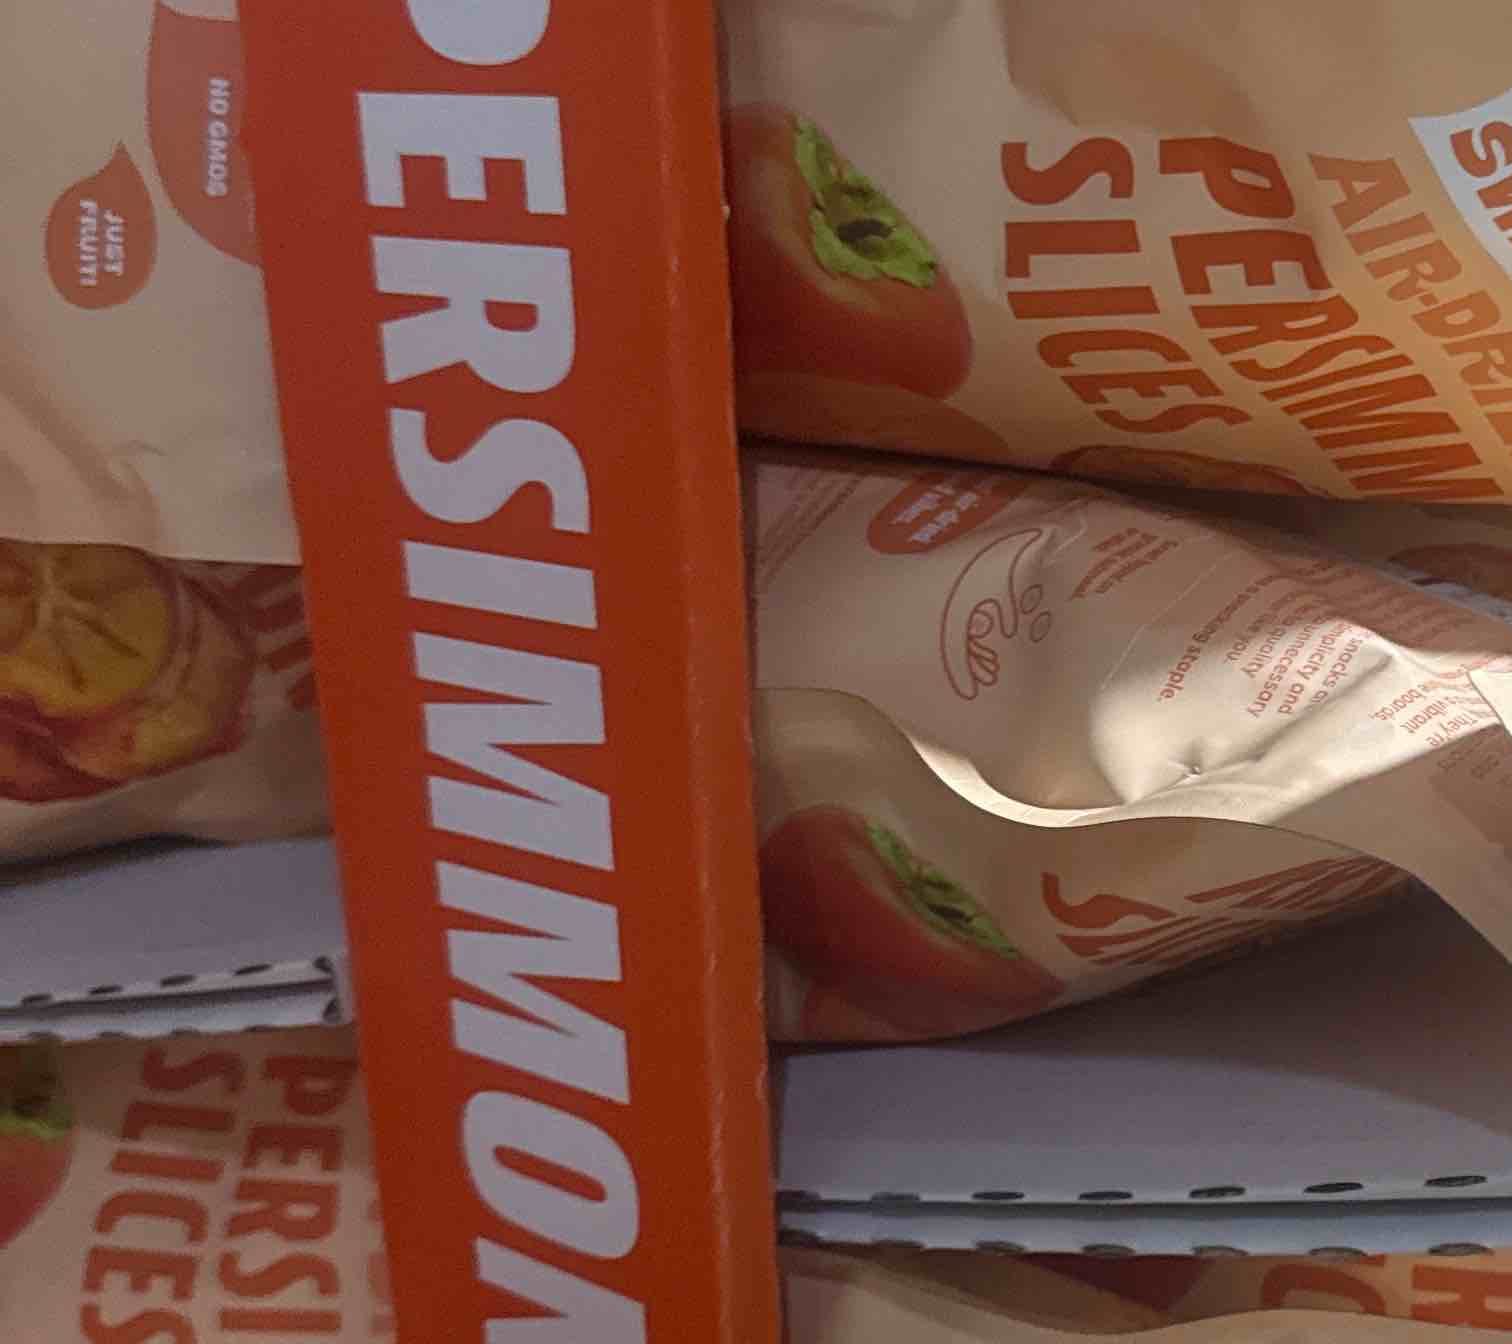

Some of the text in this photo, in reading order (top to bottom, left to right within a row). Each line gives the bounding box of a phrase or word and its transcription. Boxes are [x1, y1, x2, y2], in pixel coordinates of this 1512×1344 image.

[204, 76, 231, 198] NO GMOS
[101, 208, 126, 278] JUST
[1000, 136, 1253, 436] SLICES
[1158, 136, 1504, 504] PERSIMM
[1155, 644, 1204, 704] staple.
[1239, 628, 1288, 679] quality
[1245, 624, 1314, 719] unnecessary
[1277, 683, 1305, 715] and
[1399, 700, 1448, 734] vibrant
